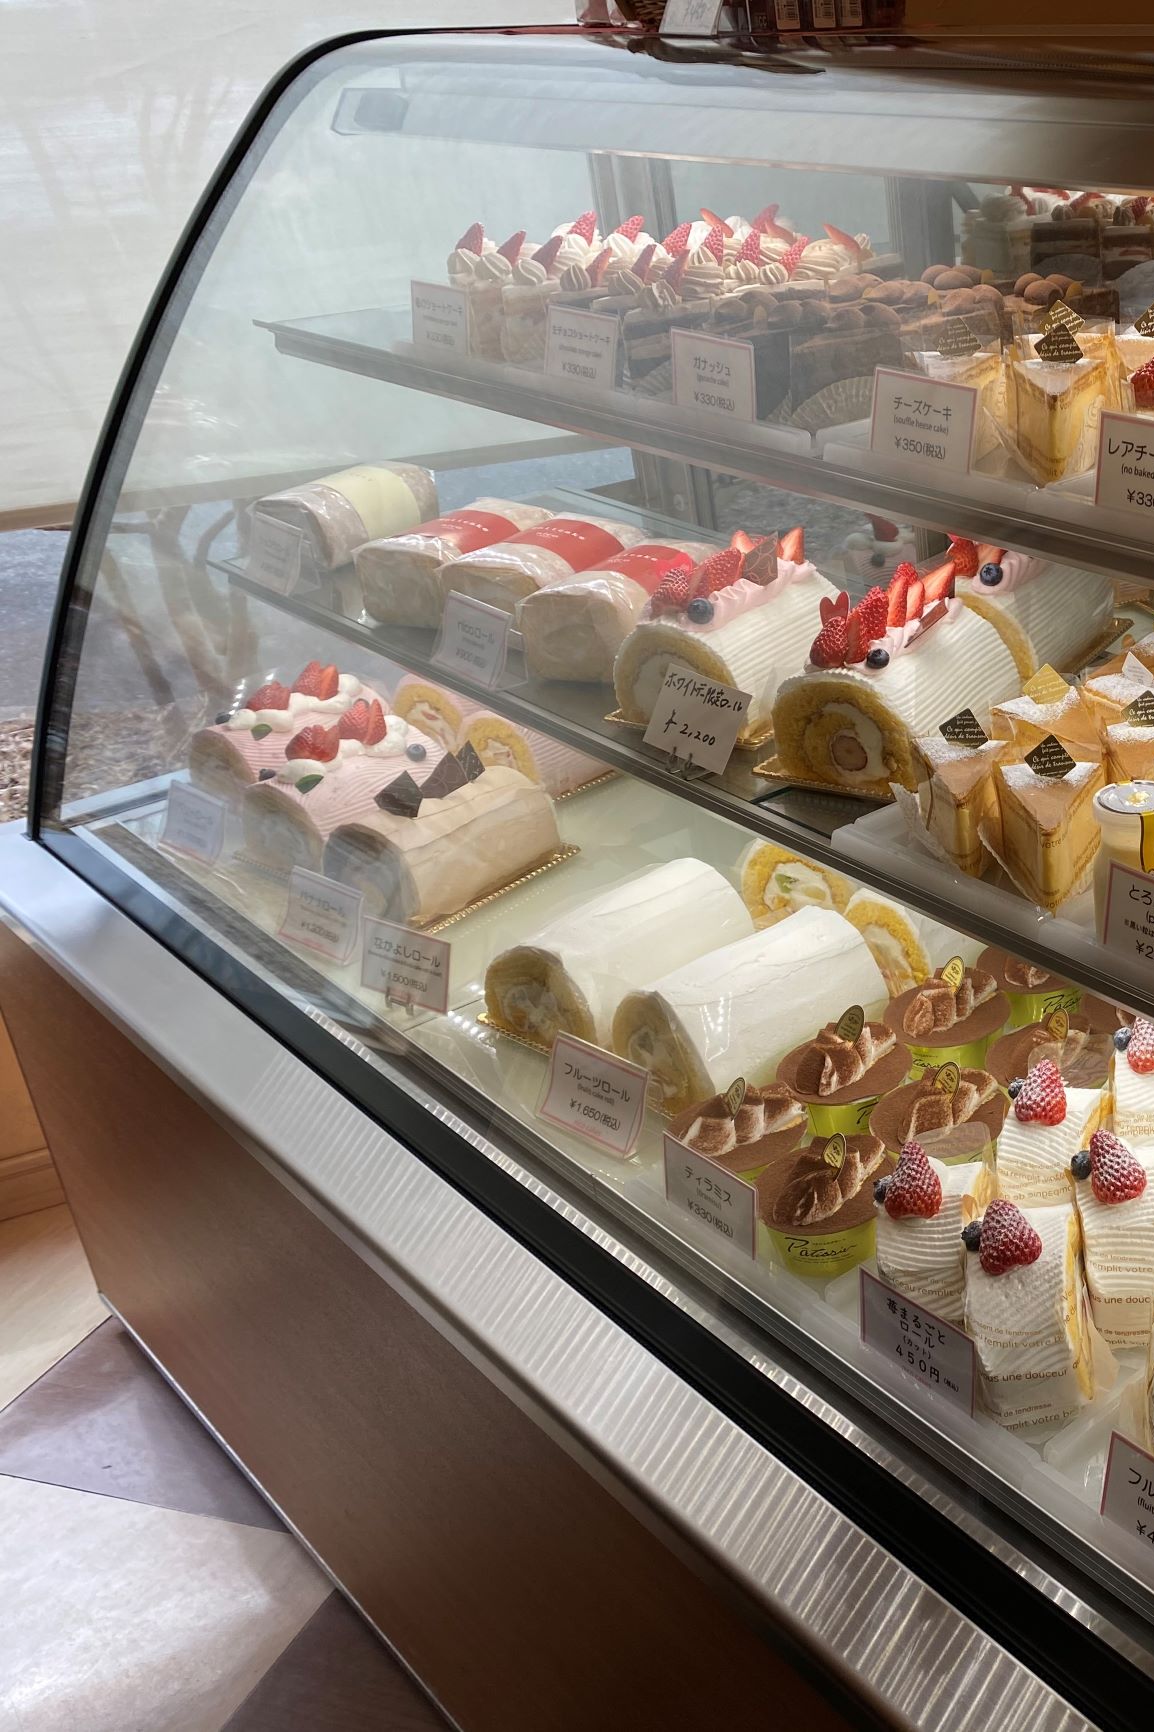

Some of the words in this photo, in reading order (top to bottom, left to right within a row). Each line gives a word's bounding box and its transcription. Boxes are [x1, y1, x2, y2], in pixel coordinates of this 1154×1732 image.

[693, 355, 731, 377] ガナッシュ
[893, 396, 953, 422] チーズケーキ
[894, 435, 947, 461] ¥350(税込)
[1121, 463, 1132, 475] (no
[374, 936, 441, 968] なかよしロール
[564, 1062, 630, 1103] フルーツロール
[684, 1166, 733, 1207] ティラミス
[1104, 1296, 1124, 1304] une
[886, 1298, 946, 1345] 苺まるごと
[900, 1320, 936, 1348] ロール
[903, 1335, 932, 1360] (カット)
[1002, 1370, 1022, 1382] une
[1024, 1368, 1068, 1380] douceur
[1032, 1413, 1061, 1426] votre
